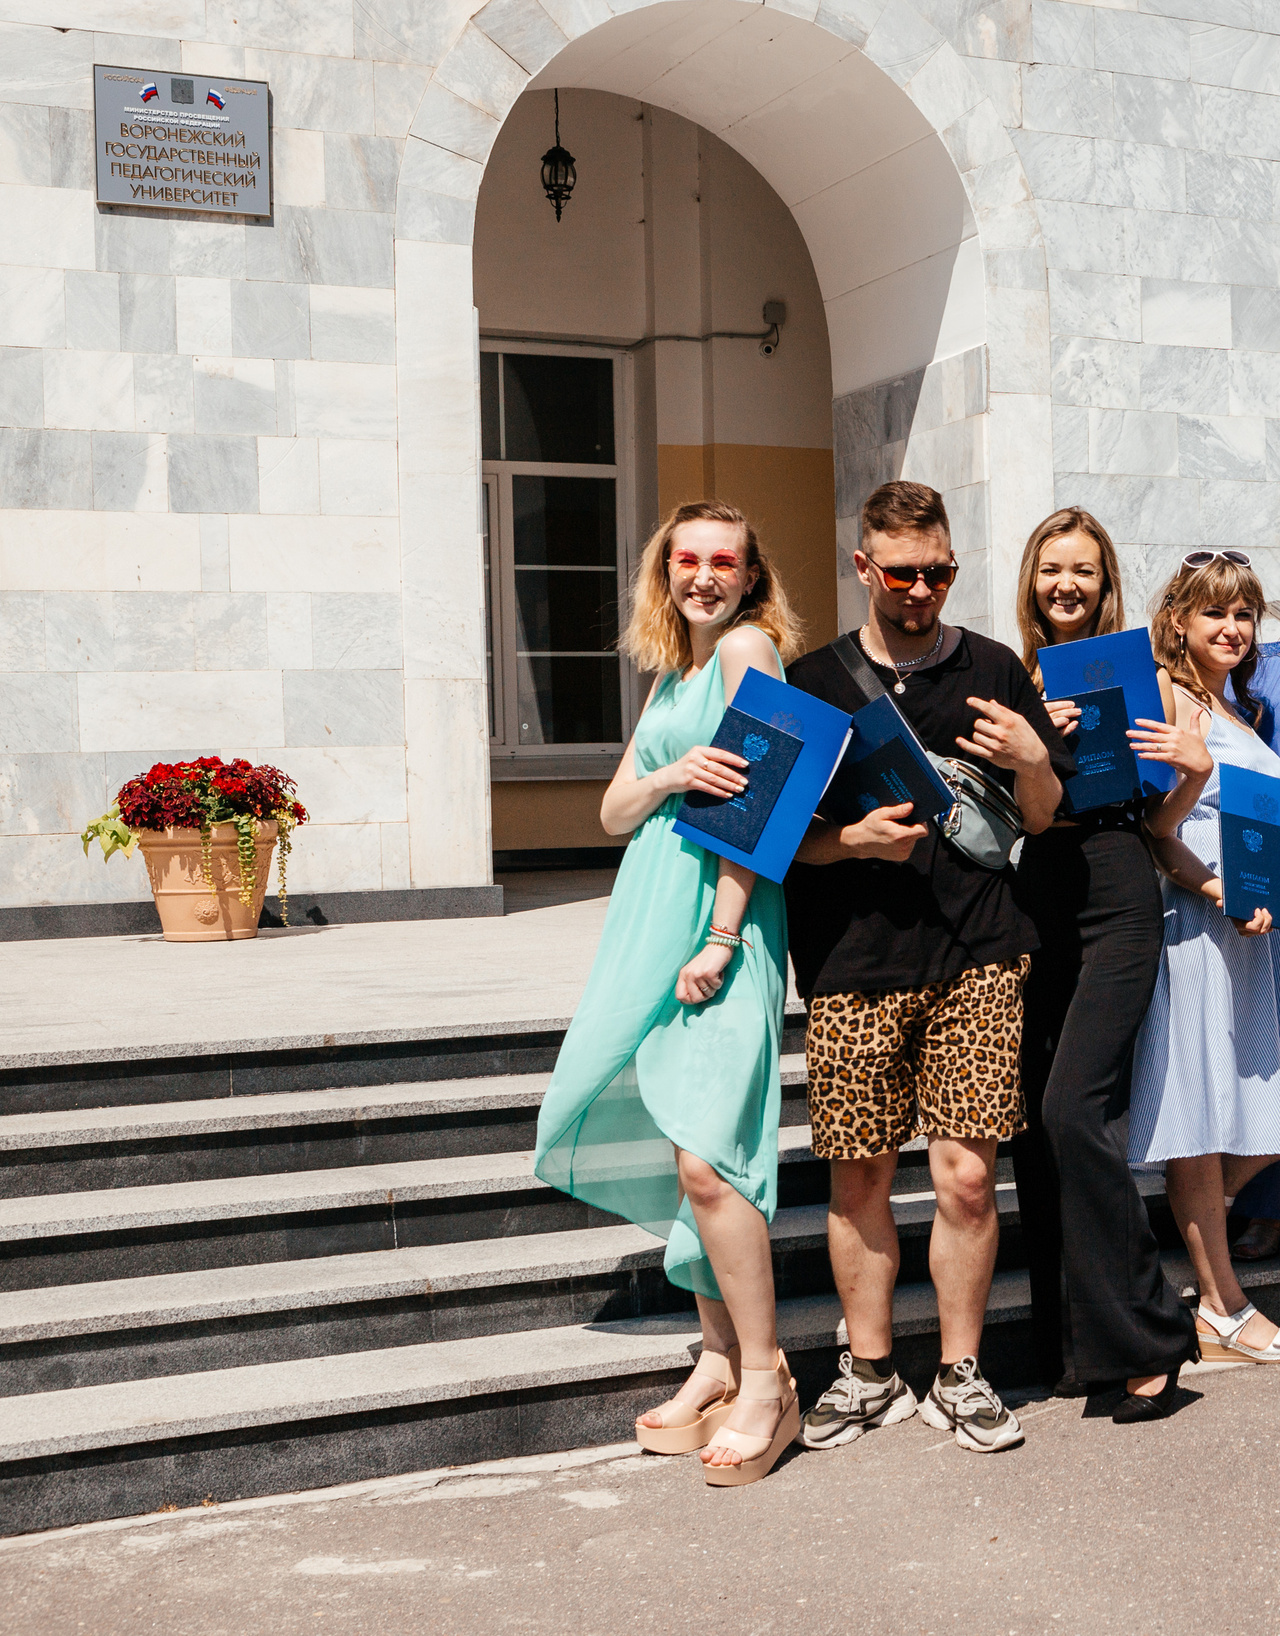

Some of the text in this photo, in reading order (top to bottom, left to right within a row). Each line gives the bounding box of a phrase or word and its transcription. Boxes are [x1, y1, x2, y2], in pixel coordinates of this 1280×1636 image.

[123, 106, 230, 123] МИНИСТЕРСТВО ПРОСВЕЩЕНИЯ
[180, 119, 221, 129] ФЕДЕРАЦИИ
[120, 123, 246, 148] ВОРОНЕЖСКИЙ
[105, 141, 261, 169] ГОСУДАРСТВЕННЫЙ
[110, 162, 256, 189] ПЕДАГОГИЧЕСКИЙ
[129, 183, 239, 207] УНИВЕРСИТЕТ
[1078, 750, 1115, 765] ДИПЛОМ
[1239, 871, 1270, 884] ДИПЛОМ
